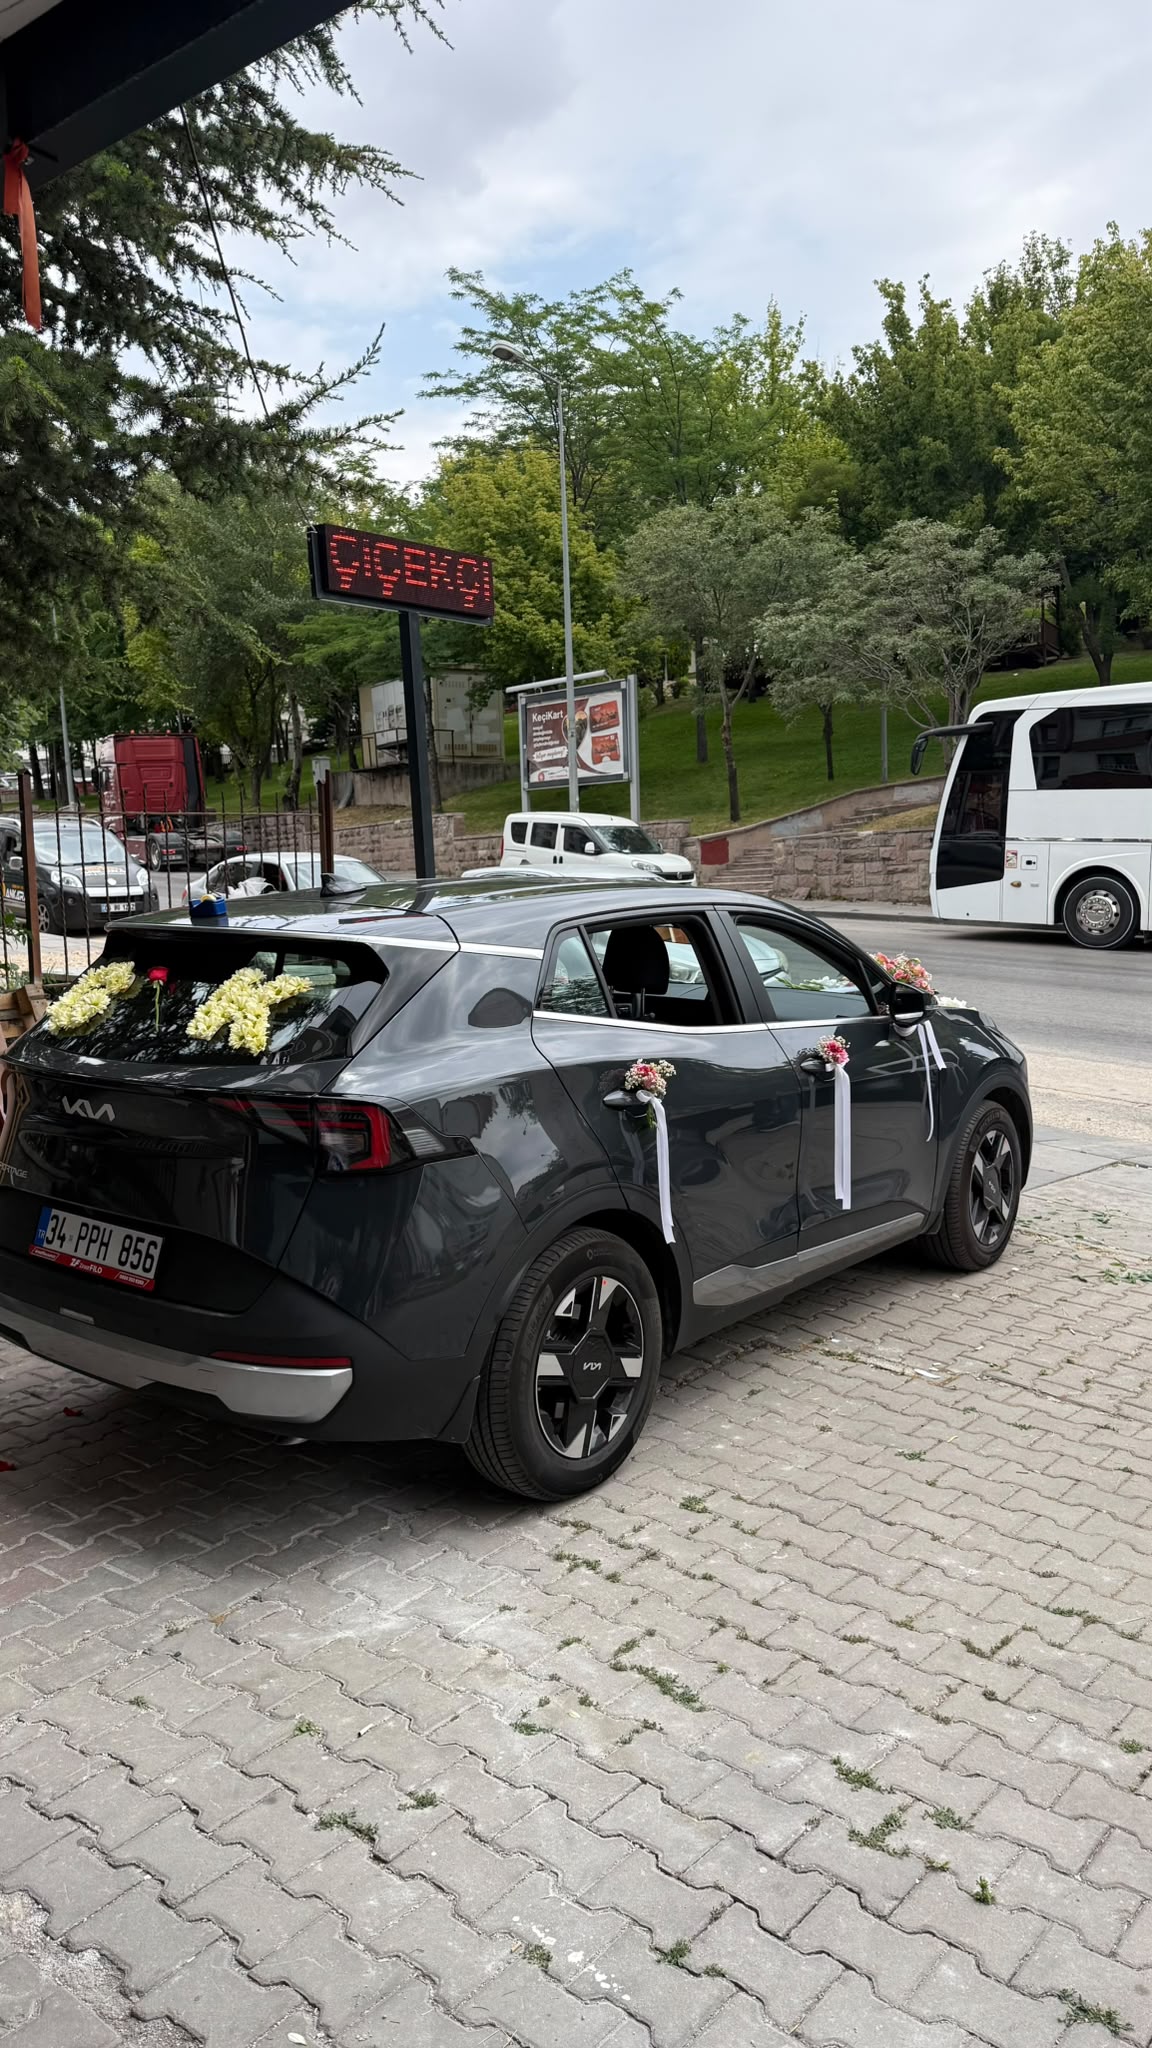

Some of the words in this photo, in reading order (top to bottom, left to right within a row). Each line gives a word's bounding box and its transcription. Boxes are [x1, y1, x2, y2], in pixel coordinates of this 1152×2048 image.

[532, 709, 563, 724] KeçiKart
[61, 1095, 116, 1122] KIA
[37, 1228, 46, 1239] TR
[45, 1214, 67, 1249] 34
[73, 1222, 113, 1262] PPH
[117, 1234, 158, 1274] 856
